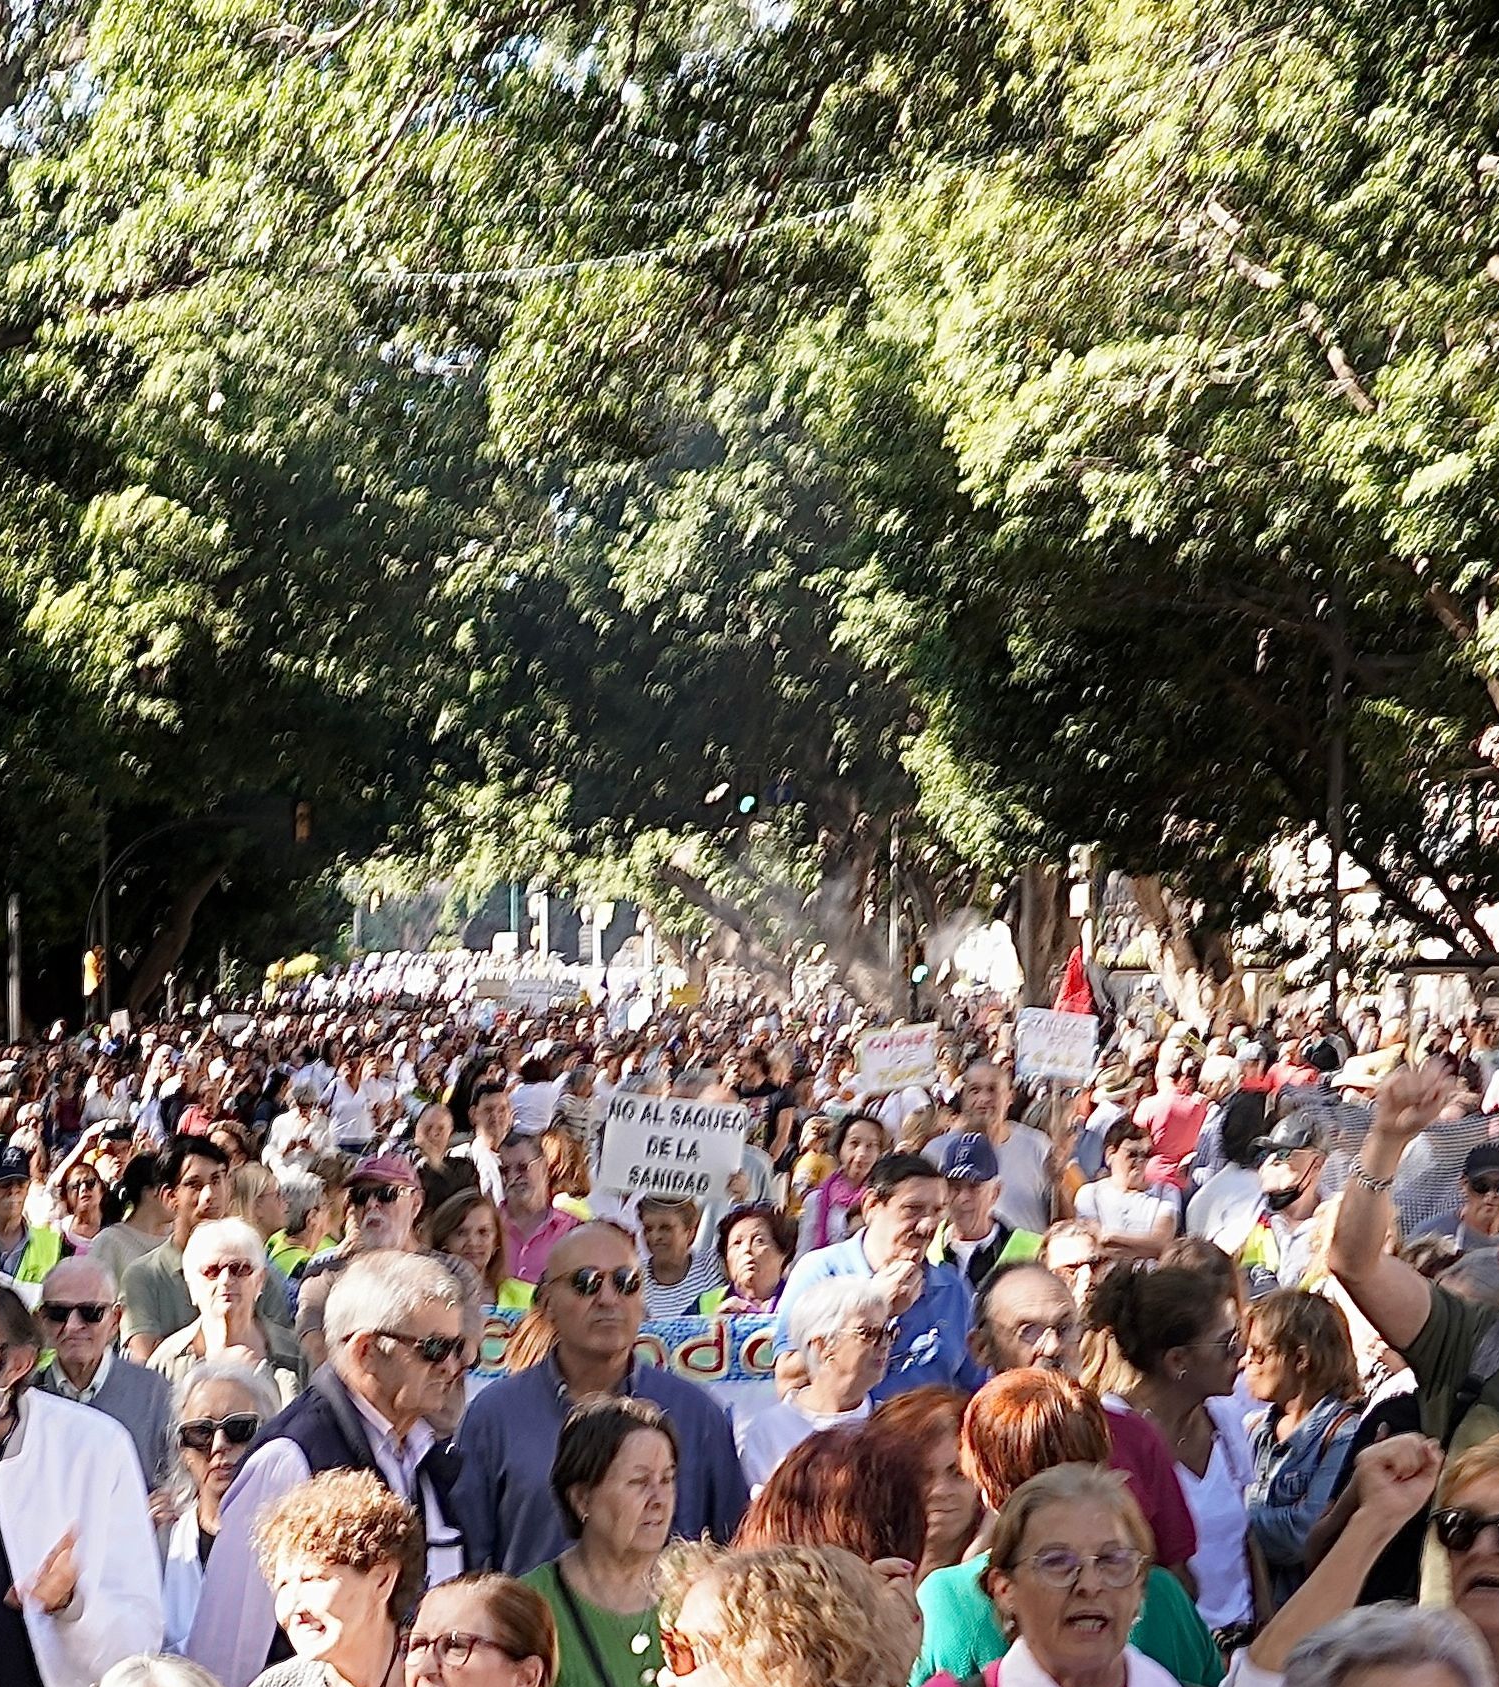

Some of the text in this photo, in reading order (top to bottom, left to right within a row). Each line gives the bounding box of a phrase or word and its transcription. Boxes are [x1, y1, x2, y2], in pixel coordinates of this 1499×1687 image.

[608, 1097, 635, 1121] NO
[640, 1102, 664, 1126] AL
[645, 1134, 700, 1164] DE LA
[628, 1164, 711, 1195] SANIDAD
